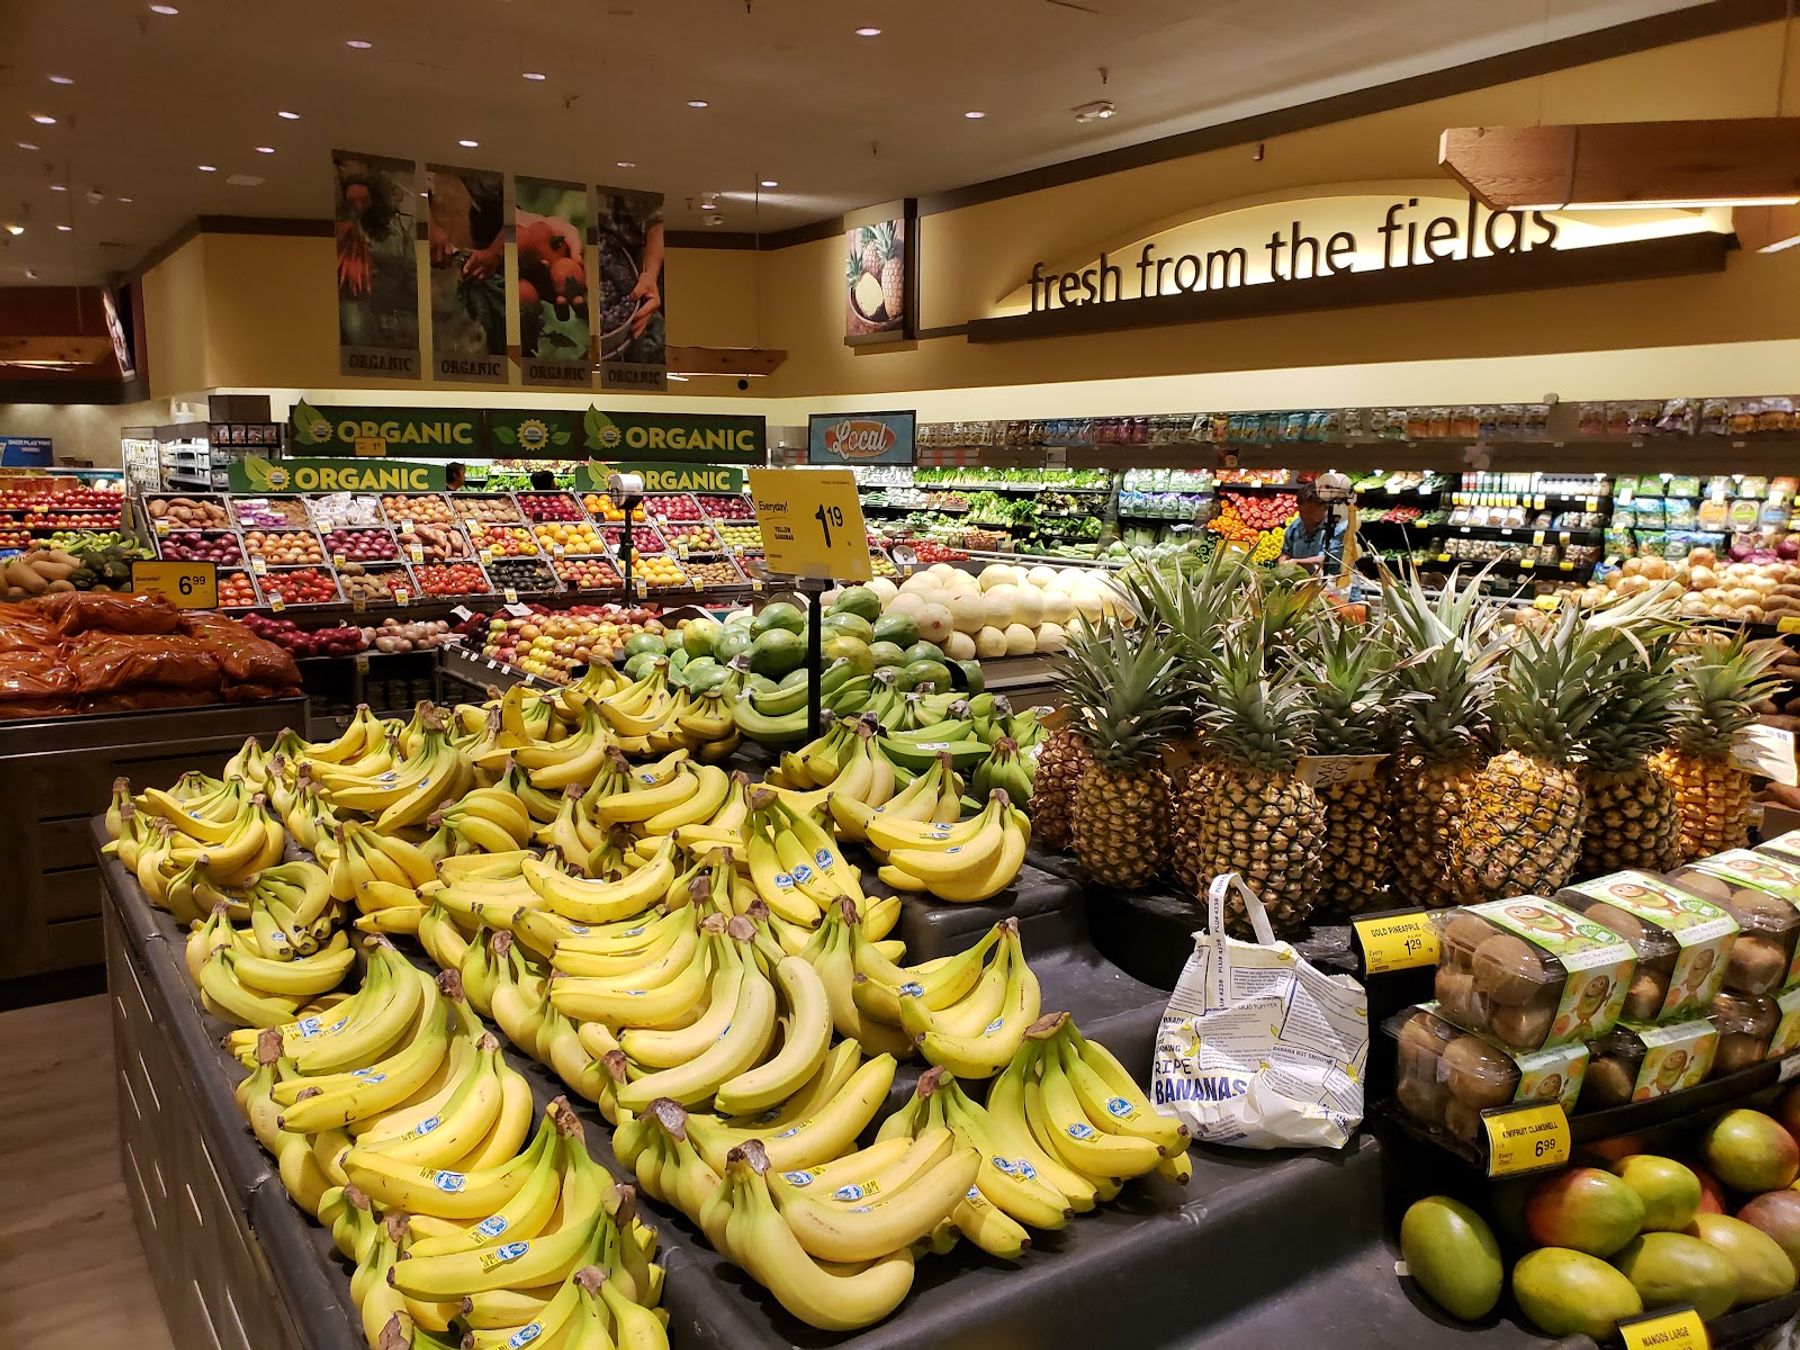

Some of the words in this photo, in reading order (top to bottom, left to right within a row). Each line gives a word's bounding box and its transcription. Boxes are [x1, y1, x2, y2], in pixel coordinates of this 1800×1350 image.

[1028, 252, 1121, 311] fresh
[1137, 243, 1246, 297] from
[1265, 221, 1356, 281] the
[1377, 192, 1558, 268] fields
[349, 354, 413, 371] ORGANIC
[441, 360, 501, 376] ORGANIC
[530, 365, 585, 380] ORGANIC
[608, 369, 661, 384] ORGANIC
[337, 420, 473, 444] ORGANIC
[625, 427, 754, 450] ORGANIC
[832, 419, 888, 460] Local
[295, 468, 429, 490] ORGANIC
[1371, 928, 1388, 937] GOLD
[1388, 923, 1421, 934] PINEAPPLE
[1156, 1058, 1191, 1076] RIPE
[1155, 1076, 1247, 1105] BANANAS
[1502, 1127, 1527, 1138] KIWIFRUIT
[1641, 1331, 1669, 1346] MANGOS
[1669, 1326, 1689, 1340] LARGE
